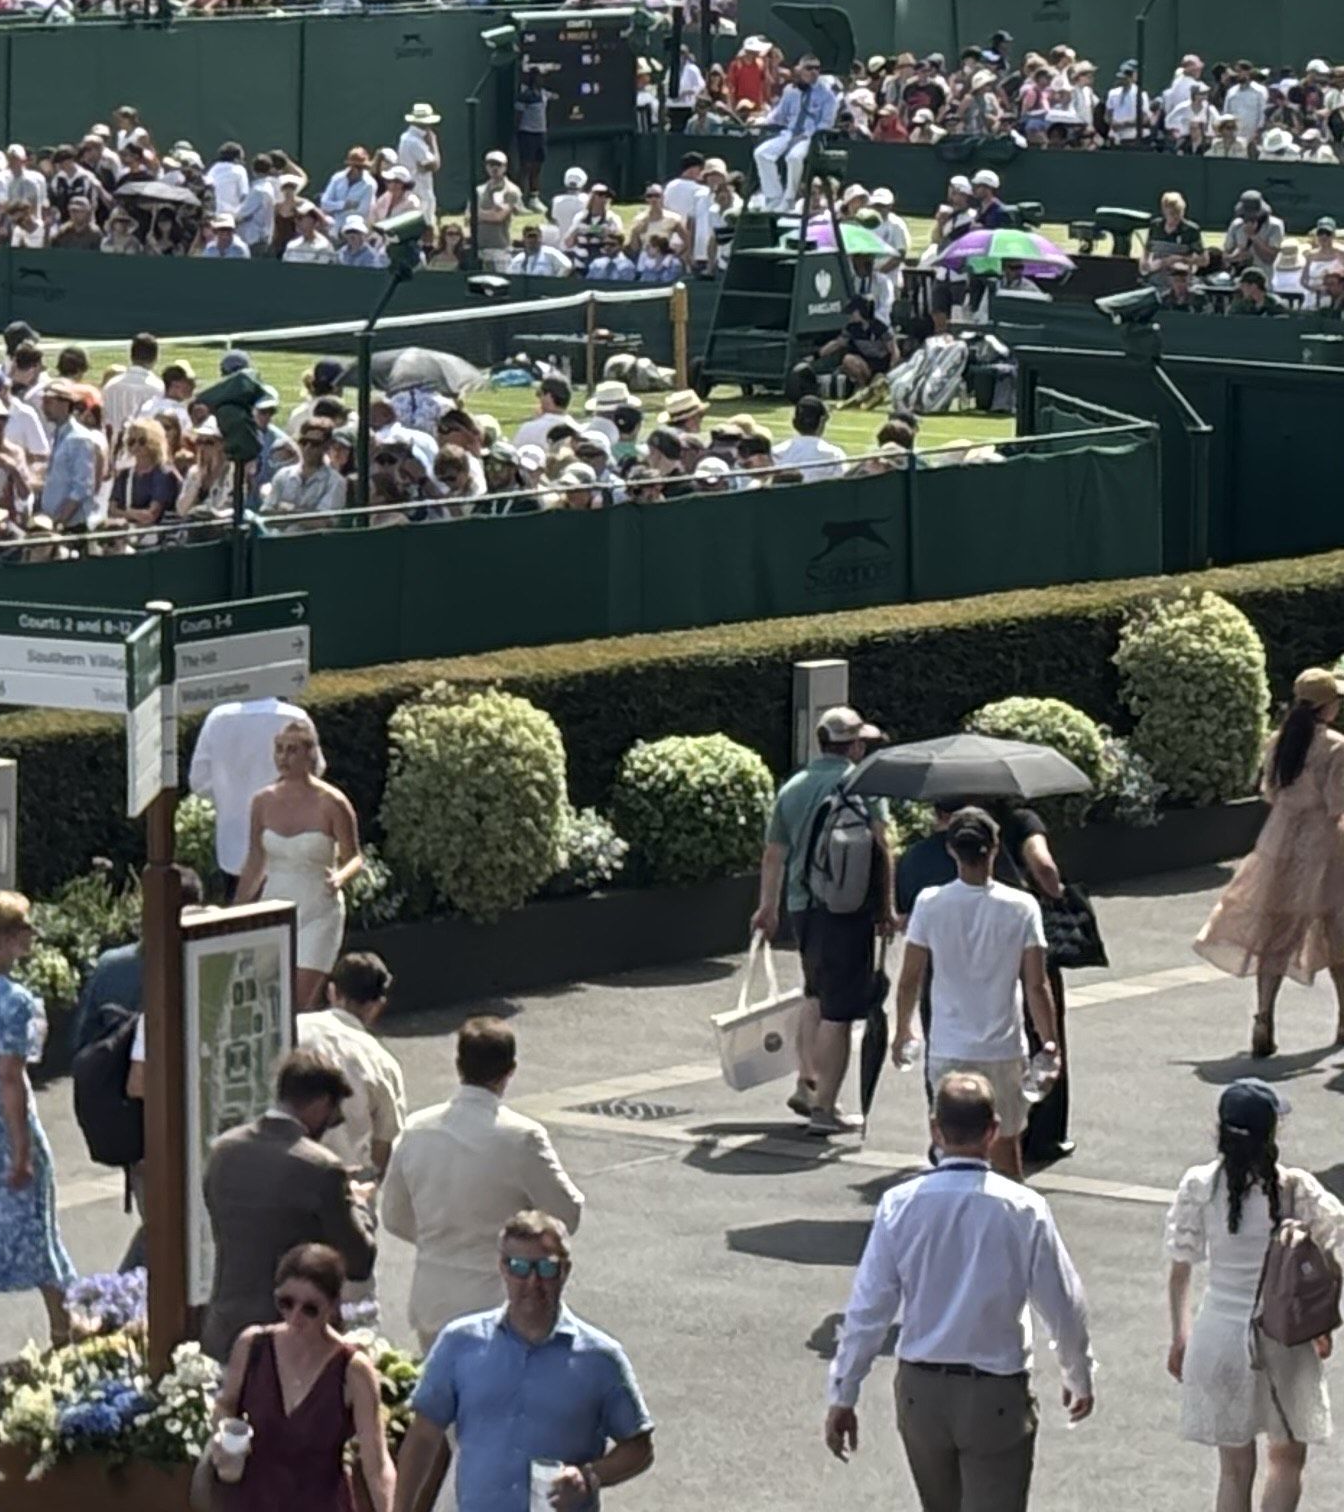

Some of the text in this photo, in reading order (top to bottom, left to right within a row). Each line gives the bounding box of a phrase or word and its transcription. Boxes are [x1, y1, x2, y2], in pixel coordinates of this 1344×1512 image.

[18, 613, 61, 632] Courts
[64, 617, 73, 632] 2
[76, 619, 101, 633] and
[27, 648, 86, 666] Southern
